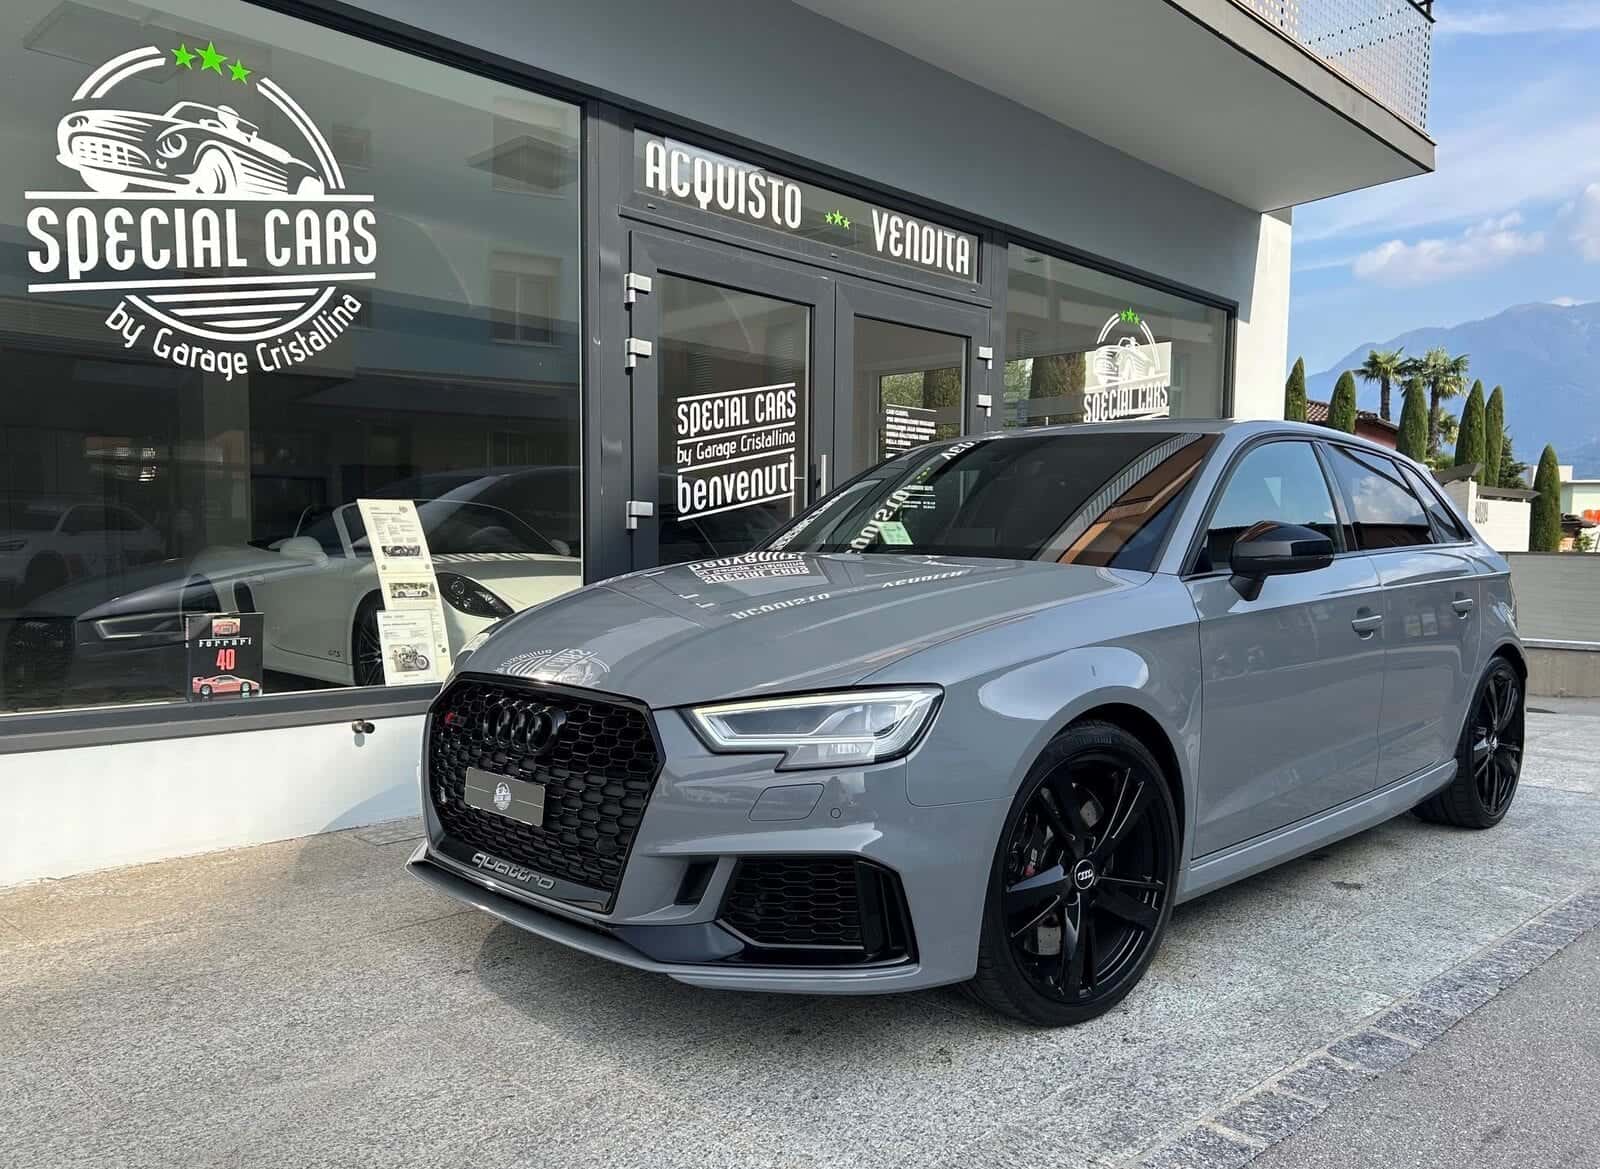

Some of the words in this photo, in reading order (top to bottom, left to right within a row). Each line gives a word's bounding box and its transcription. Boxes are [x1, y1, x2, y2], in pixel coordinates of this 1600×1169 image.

[645, 139, 802, 229] ACQUISTO
[27, 206, 248, 280] SPECIAL
[264, 208, 377, 267] CARS
[871, 208, 970, 276] VENDITA
[105, 301, 146, 349] by
[152, 327, 249, 382] Garage
[255, 294, 362, 372] Cristallina
[677, 395, 750, 437] SPECIAL
[754, 389, 796, 423] CARS
[677, 445, 692, 466] by
[696, 442, 737, 459] Garage
[740, 428, 796, 452] Cristallina
[677, 453, 795, 514] benvenuti
[216, 648, 236, 671] 40
[471, 852, 555, 890] quattro
